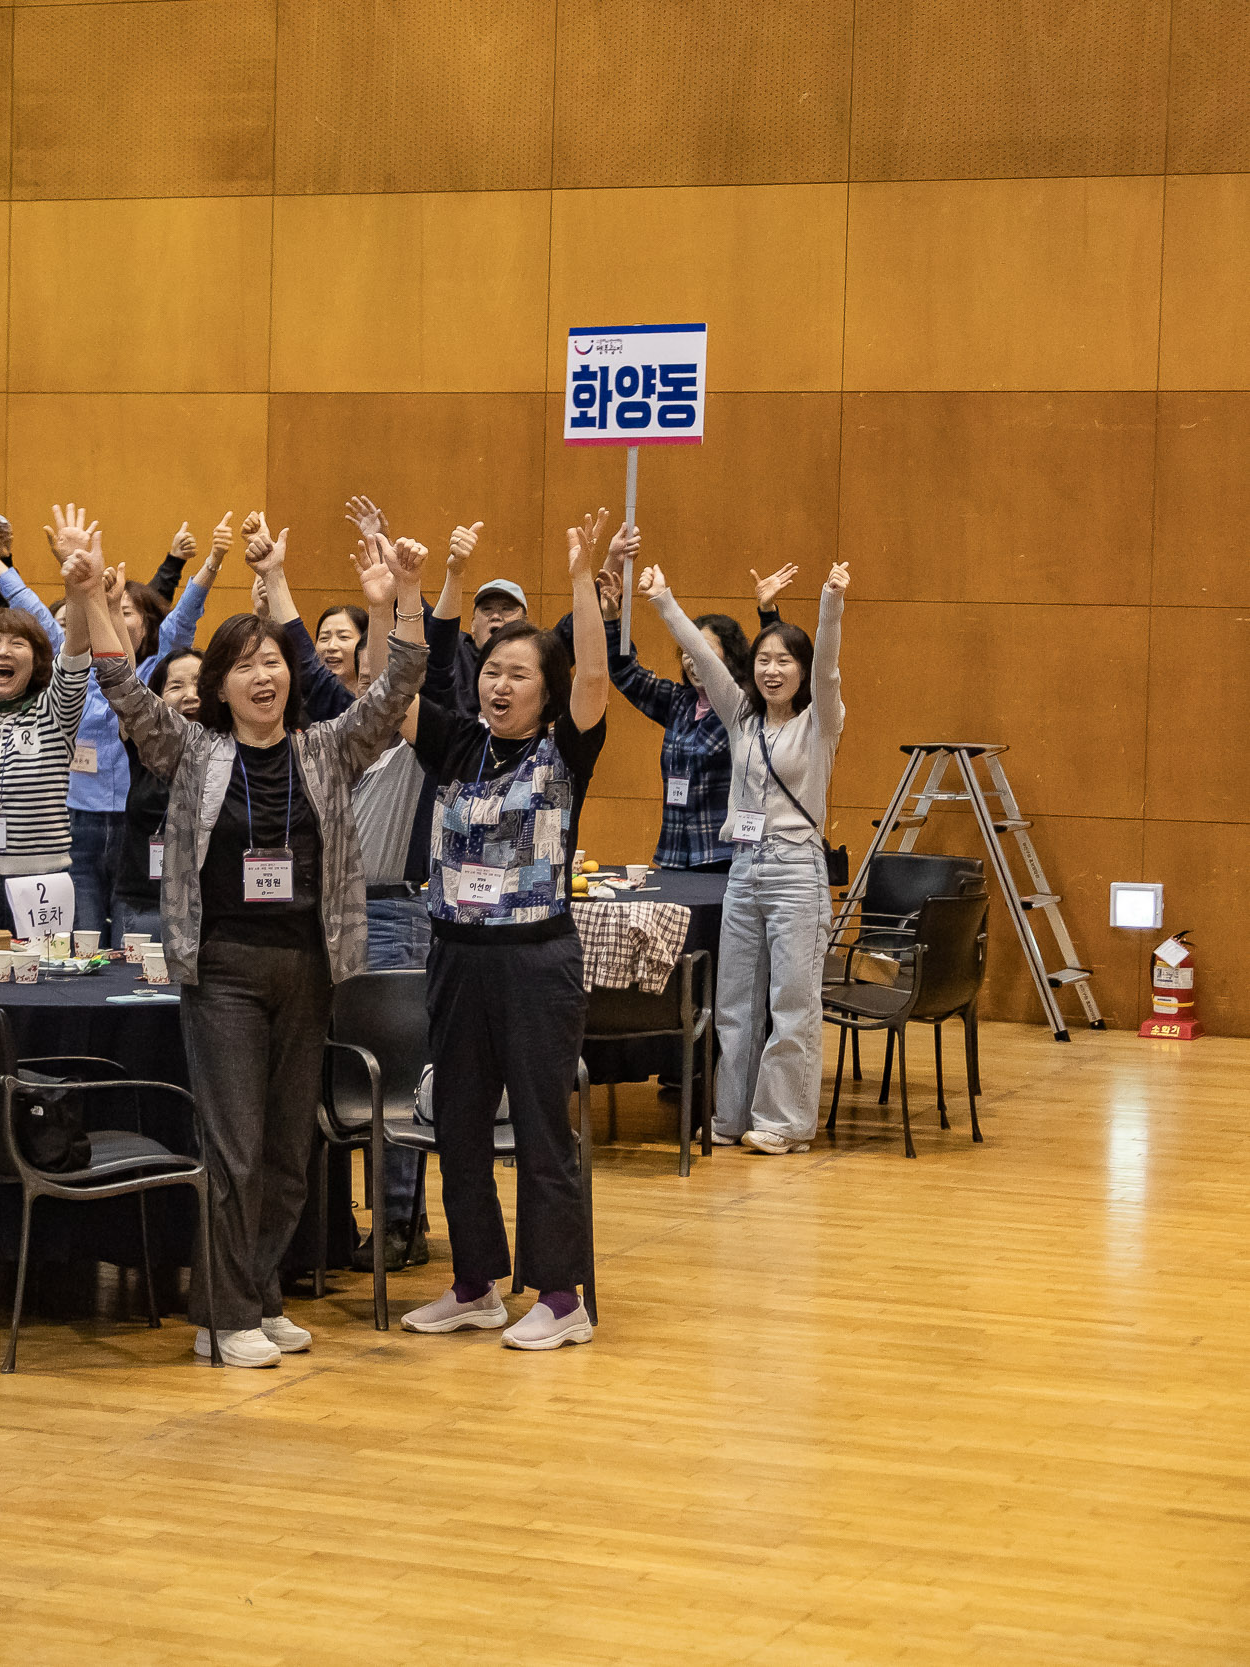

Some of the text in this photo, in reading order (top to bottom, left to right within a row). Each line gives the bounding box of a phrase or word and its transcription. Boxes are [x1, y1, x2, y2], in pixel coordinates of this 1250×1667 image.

[570, 363, 698, 429] 화양동
[21, 730, 34, 746] R
[256, 878, 281, 887] 원정원
[36, 882, 49, 905] 2
[27, 906, 64, 928] 1호차
[1150, 1024, 1180, 1036] 소화기
